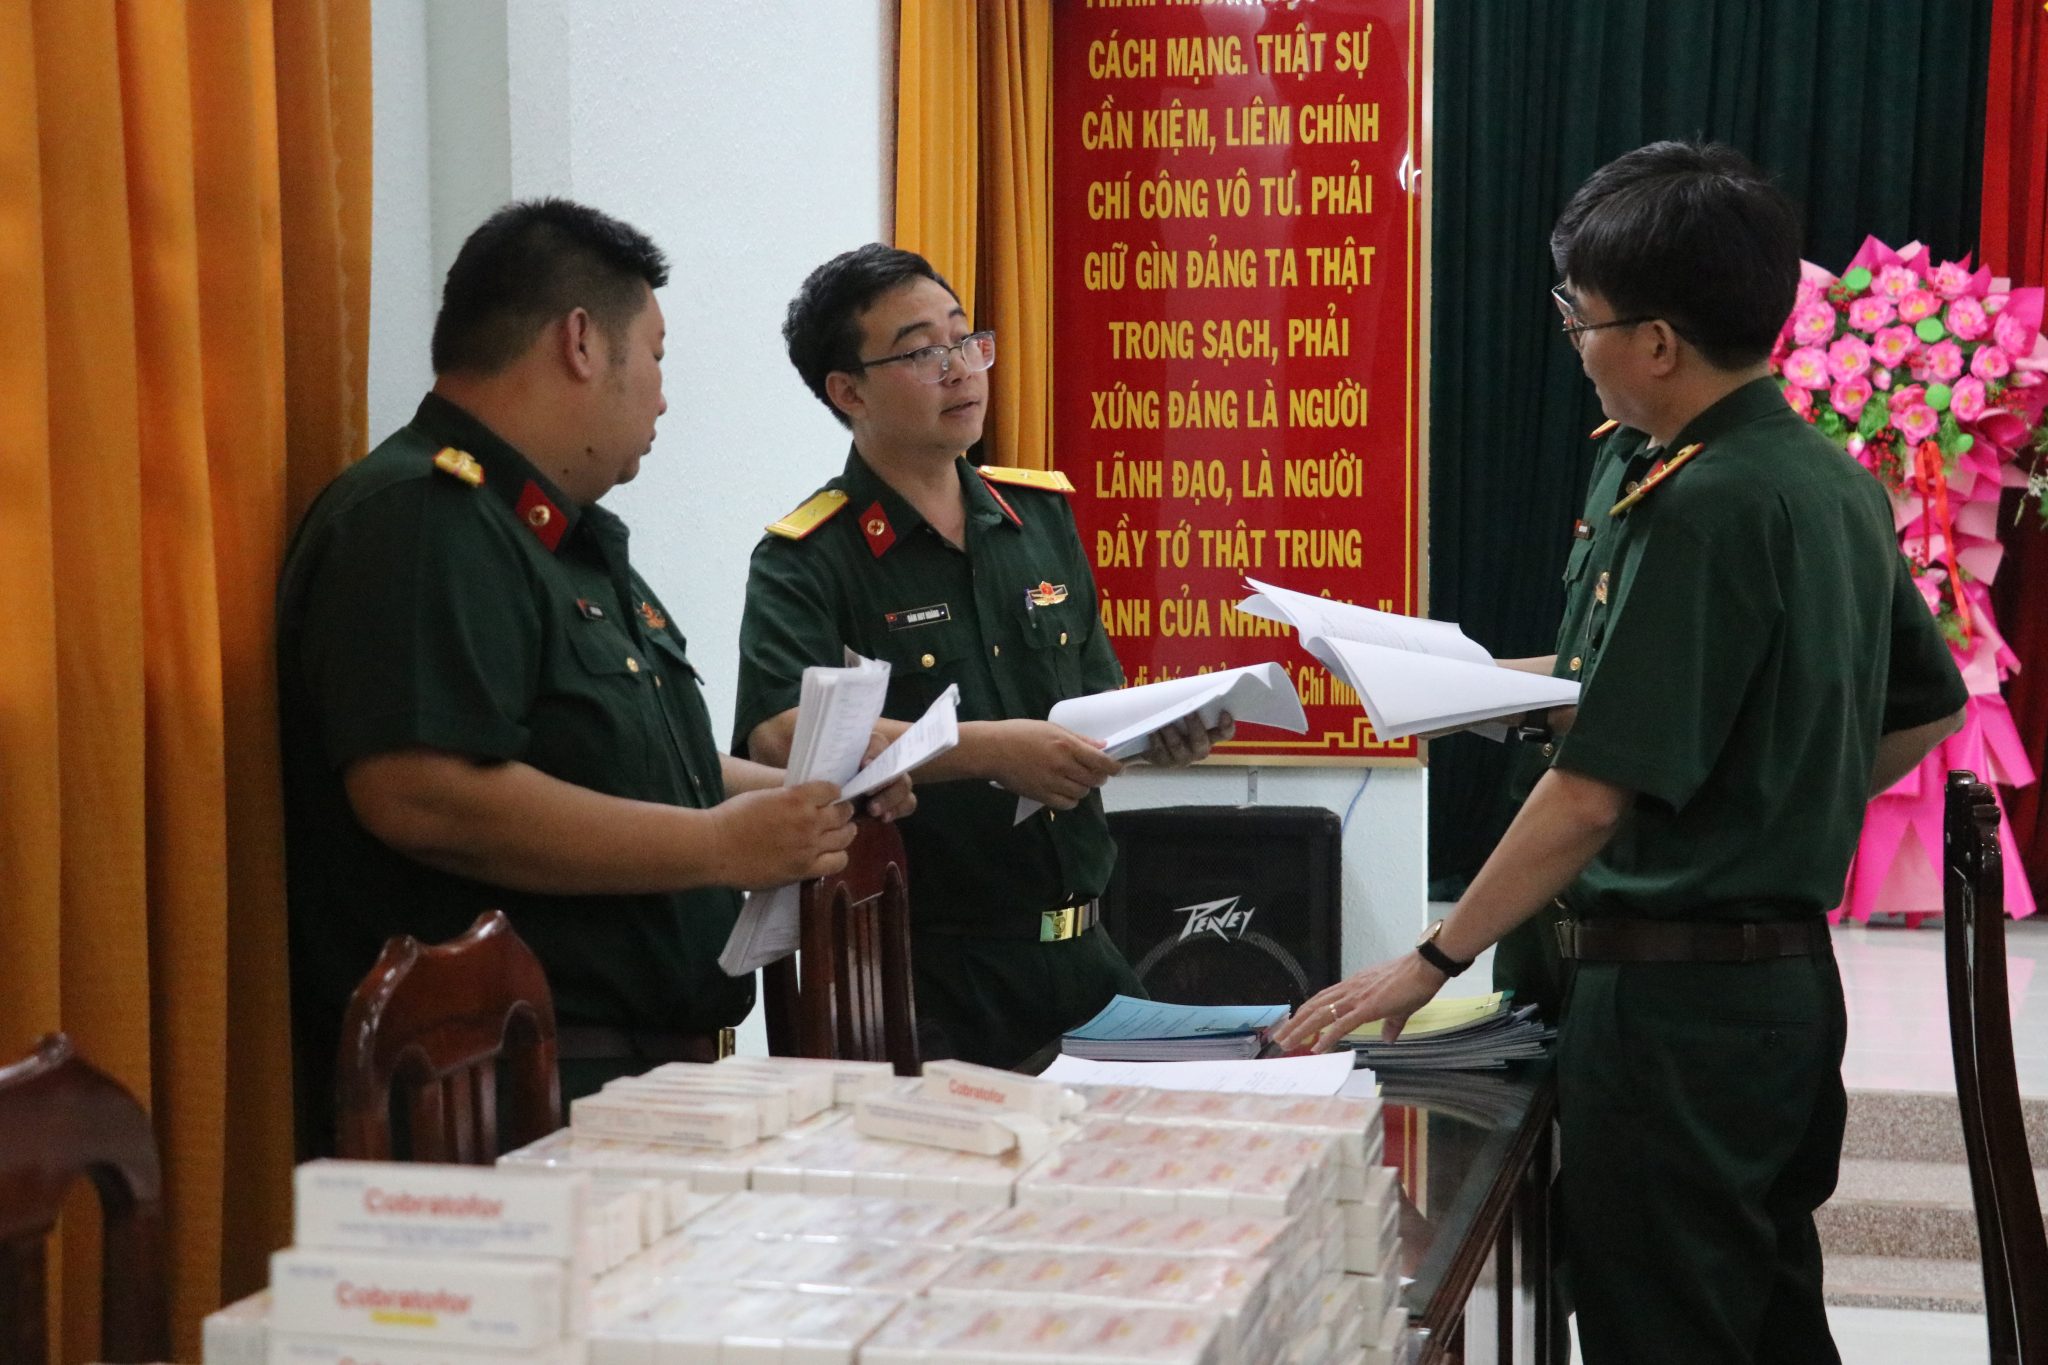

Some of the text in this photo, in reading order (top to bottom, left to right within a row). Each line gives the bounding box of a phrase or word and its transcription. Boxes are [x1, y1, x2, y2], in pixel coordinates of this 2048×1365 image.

[1090, 30, 1155, 78] CÁCH
[1258, 23, 1326, 80] THẬT
[1336, 24, 1372, 78] SỰ
[1083, 94, 1378, 155] CẦN KIỆM, LIÊM CHÍNH
[1089, 172, 1131, 219] CHÍ
[1140, 170, 1208, 218] CÔNG
[1217, 168, 1250, 217] VÔ
[1312, 160, 1372, 214] PHẢI
[1085, 235, 1375, 293] GIỮ GÌN ĐẢNG TA THẬT
[1109, 303, 1348, 366] TRONG SẠCH, PHẢI
[1092, 378, 1367, 428] XỨNG ĐÁNG LÀ NGƯỜI
[1097, 449, 1362, 505] LÃNH ĐẠO, LÀ NGƯỜI
[1097, 514, 1361, 575] ĐẦY TỚ THẬT TRUNG
[1102, 589, 1150, 636] ÀNH
[1160, 584, 1211, 637] CỦA
[1298, 666, 1326, 706] Chí
